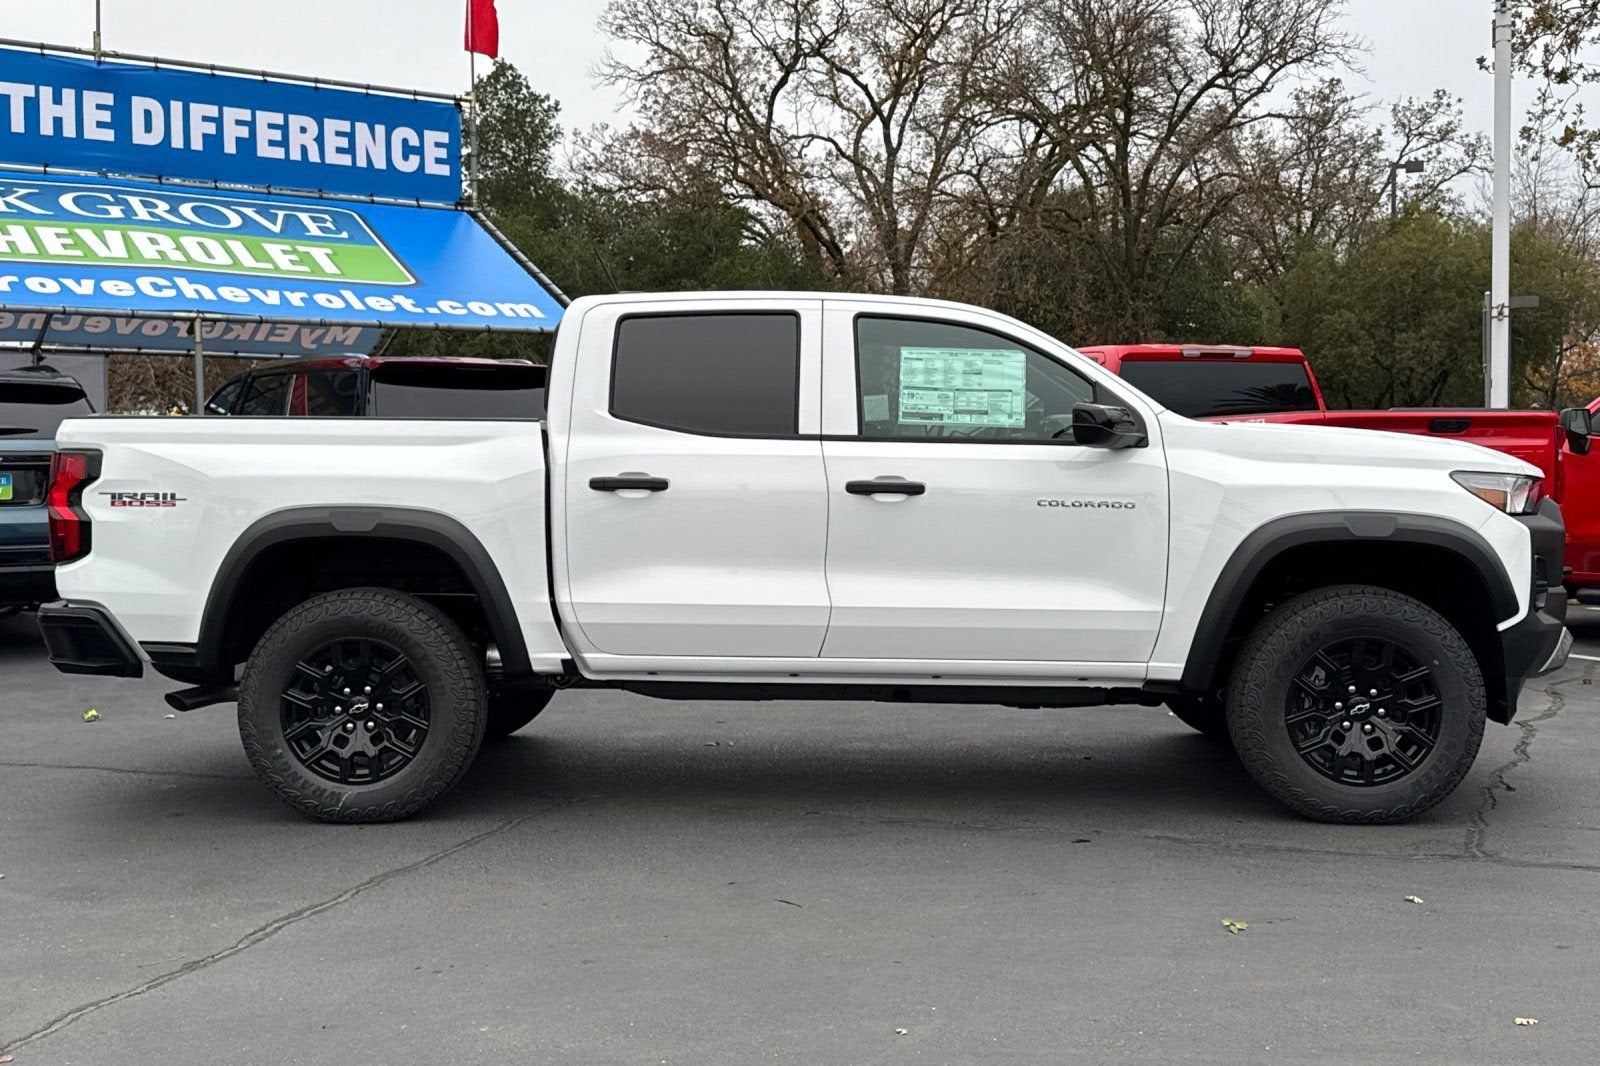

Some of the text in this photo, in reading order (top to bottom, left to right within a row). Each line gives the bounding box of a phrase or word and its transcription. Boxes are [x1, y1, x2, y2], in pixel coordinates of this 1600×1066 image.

[0, 82, 450, 176] THE DIFFERENCE
[58, 191, 349, 239] GROVE
[99, 492, 187, 501] TRAIL
[1036, 499, 1136, 509] COLORADO
